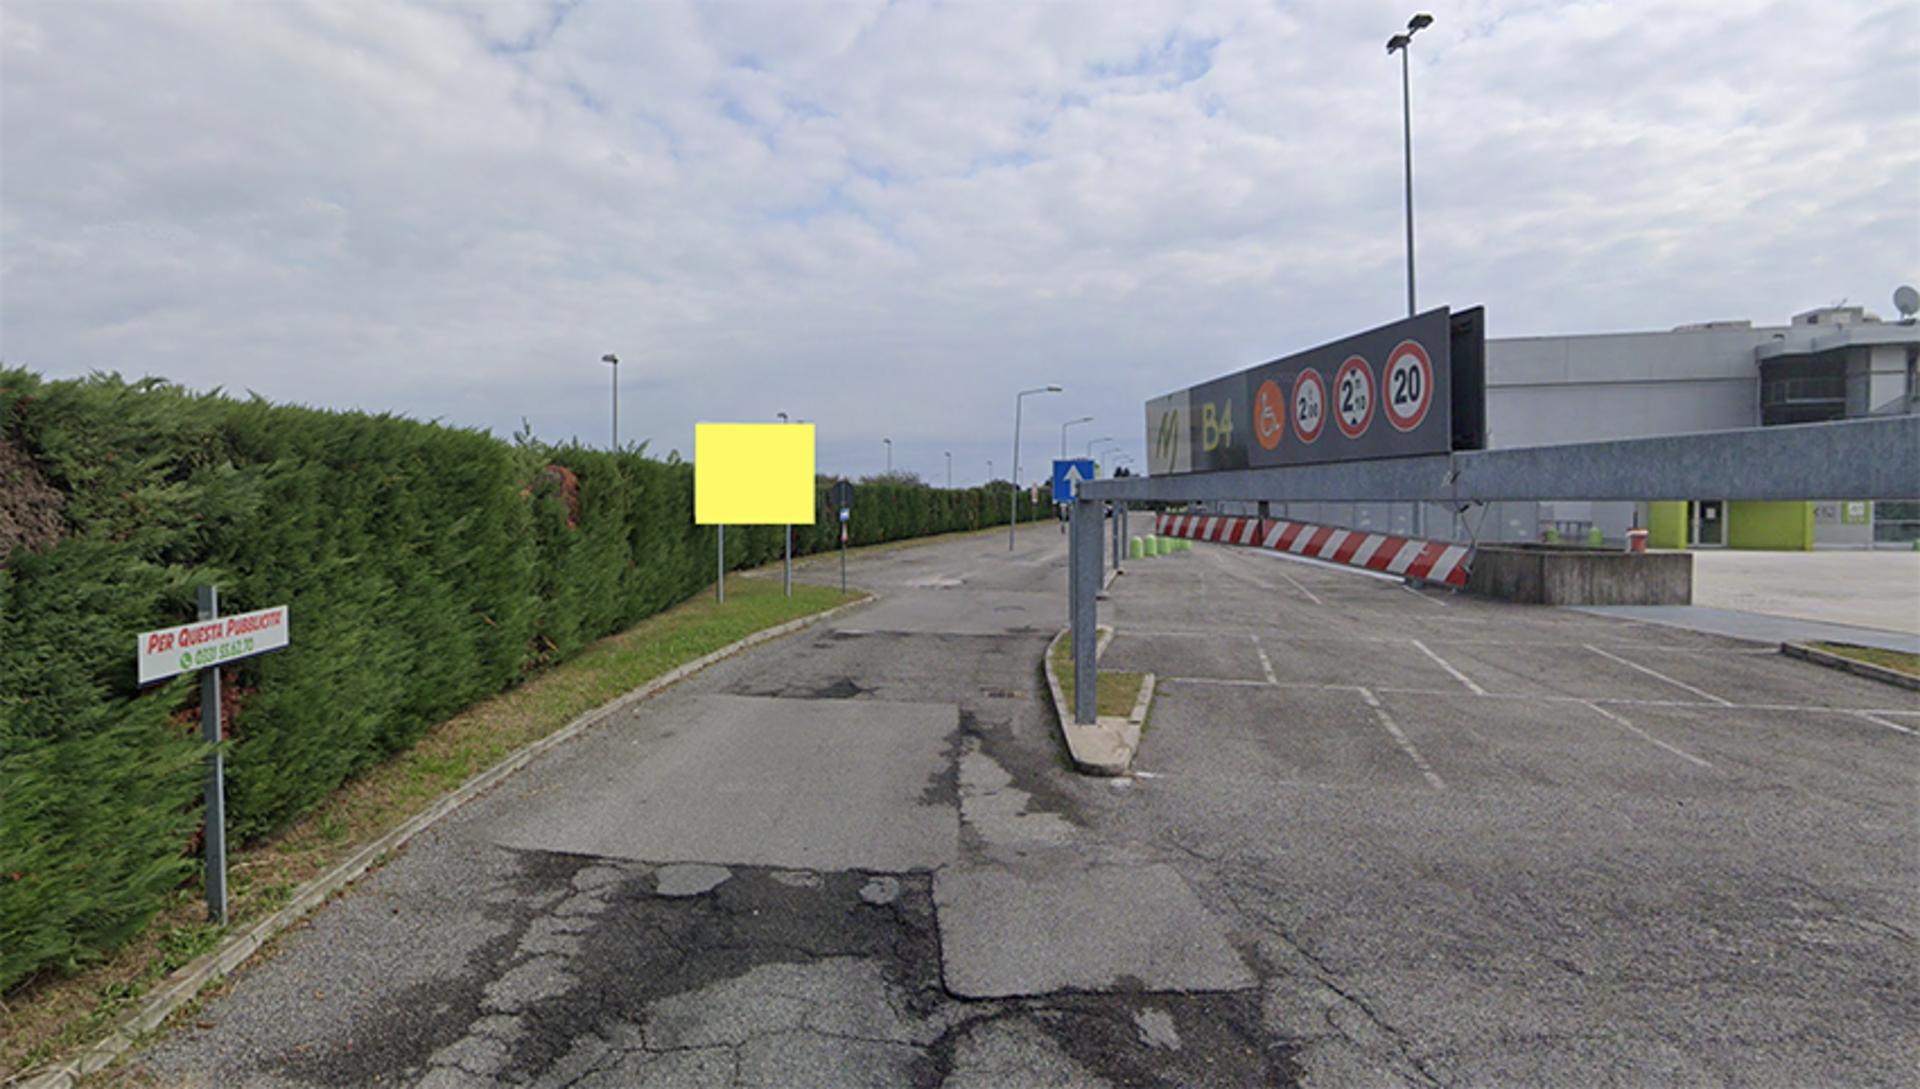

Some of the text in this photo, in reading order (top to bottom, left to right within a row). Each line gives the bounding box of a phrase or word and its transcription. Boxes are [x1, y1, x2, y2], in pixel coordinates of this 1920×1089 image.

[1394, 364, 1421, 405] 20
[1203, 397, 1234, 452] B4
[147, 634, 175, 655] PER
[178, 622, 223, 648] QUESTA
